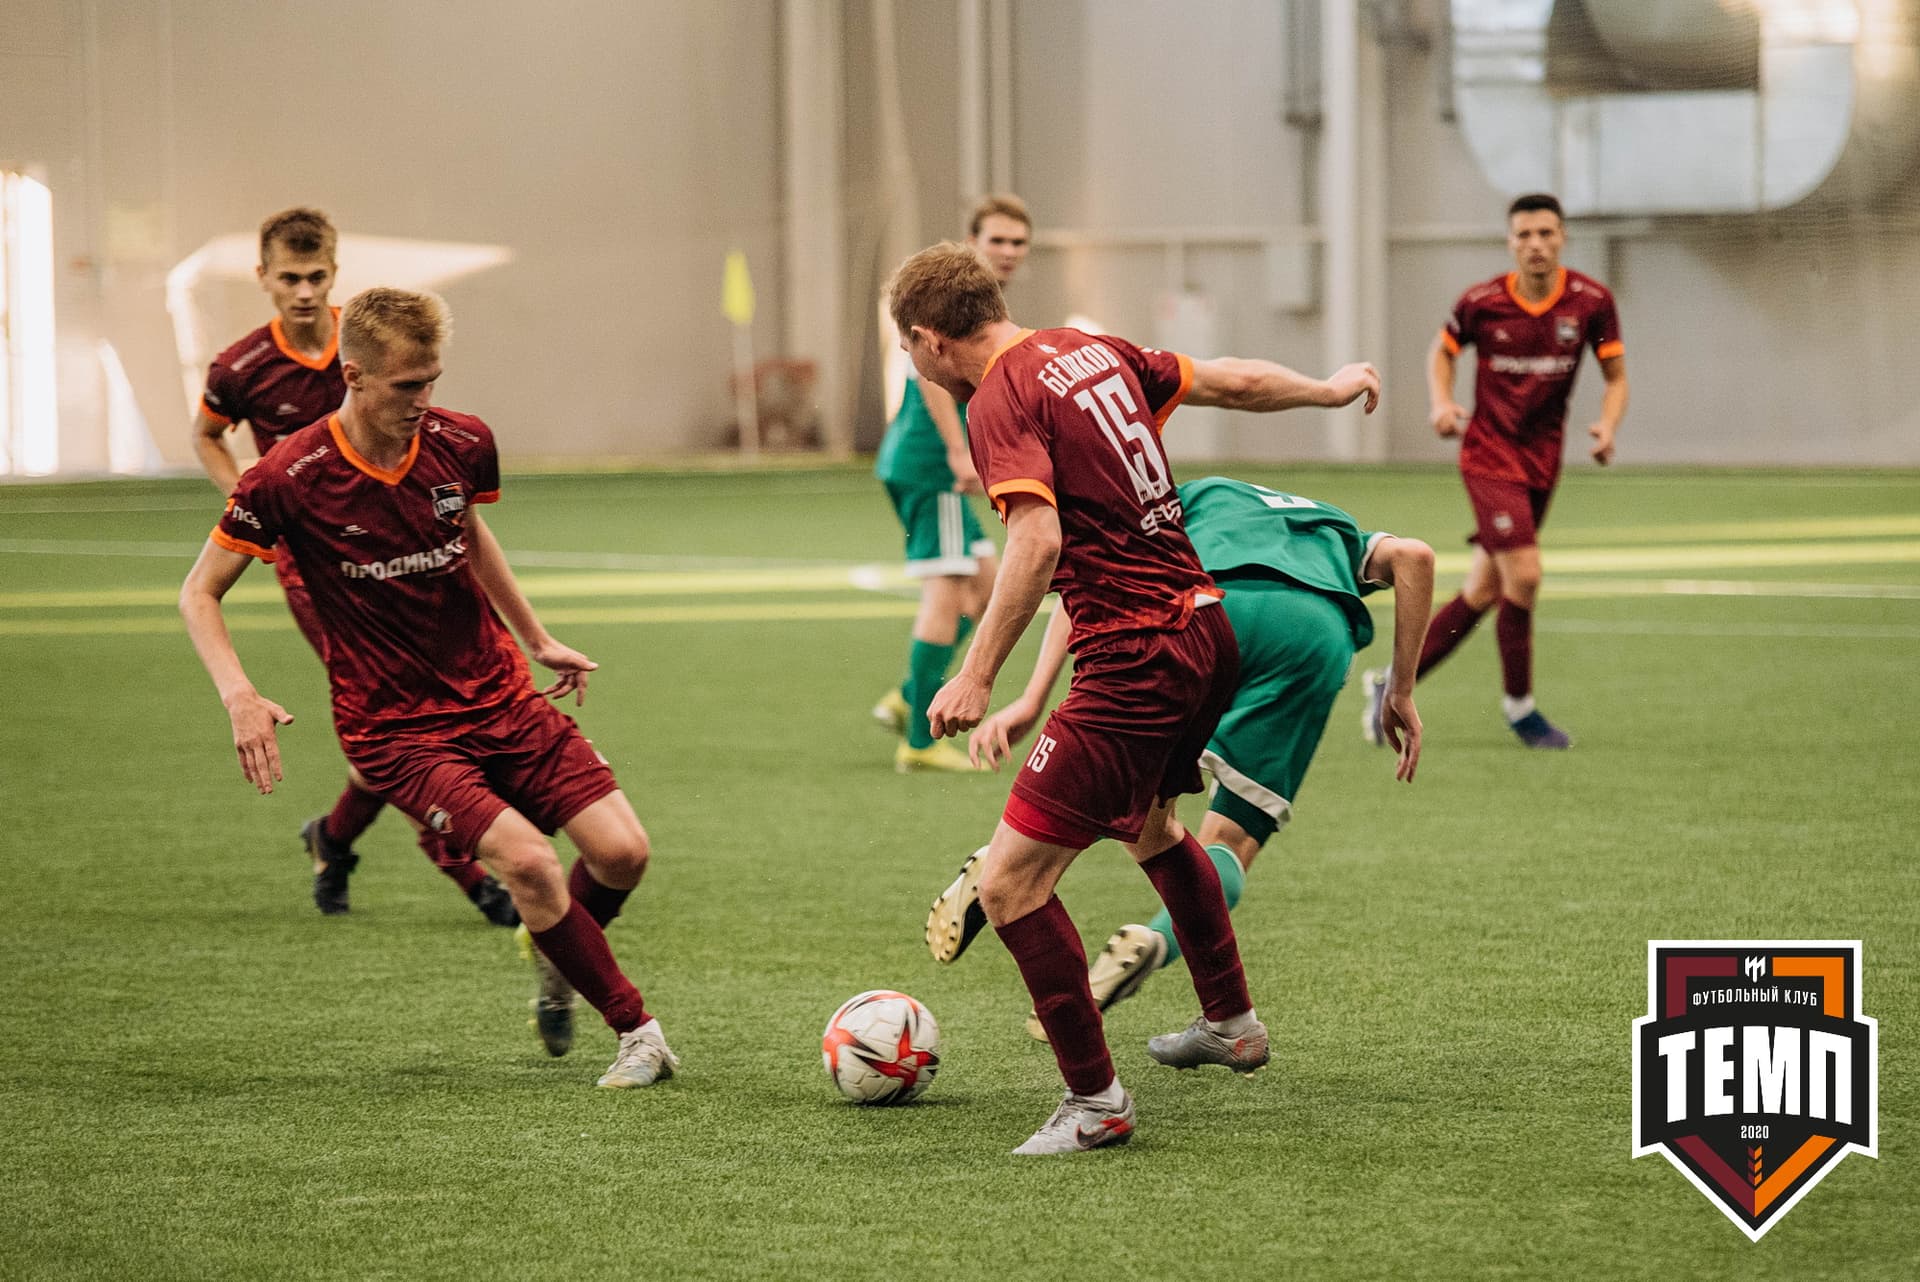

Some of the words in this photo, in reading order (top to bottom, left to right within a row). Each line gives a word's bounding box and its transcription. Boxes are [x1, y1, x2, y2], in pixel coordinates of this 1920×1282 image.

[1038, 343, 1120, 398] БЕЛИКОВ
[1073, 373, 1172, 505] 15
[1026, 733, 1057, 773] 15
